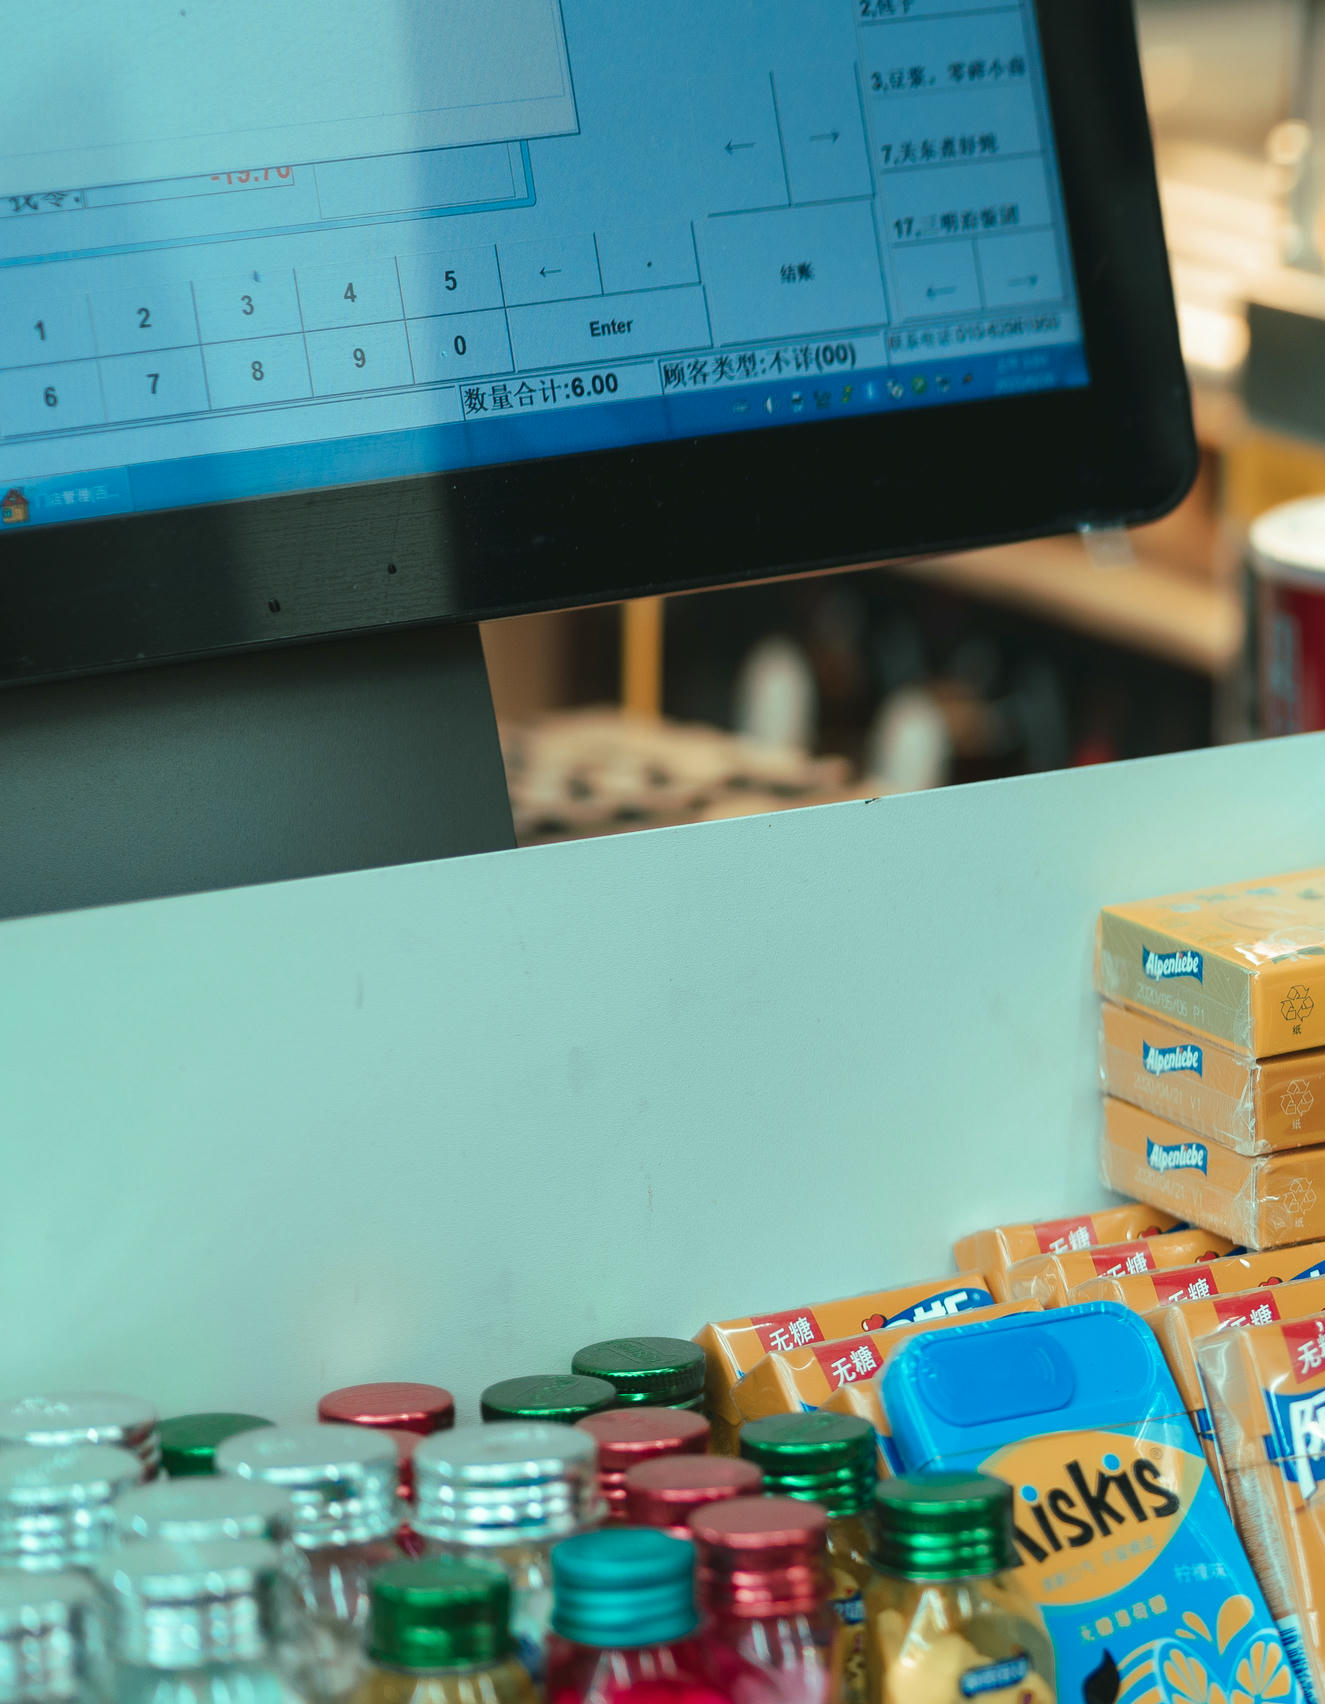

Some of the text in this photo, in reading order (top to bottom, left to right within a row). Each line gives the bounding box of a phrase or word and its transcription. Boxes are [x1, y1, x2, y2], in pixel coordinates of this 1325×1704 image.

[343, 282, 357, 302] 4
[444, 270, 459, 292] 5
[240, 294, 255, 316] 3
[137, 306, 152, 329] 2
[588, 318, 635, 337] Enter
[34, 320, 47, 341] 1
[453, 334, 468, 356] 0
[352, 347, 367, 369] 9
[251, 360, 265, 382] 8
[145, 373, 160, 394] 7
[463, 373, 619, 416] 数量合计:6.00
[43, 386, 58, 407] 6
[1146, 951, 1199, 981] Alpenliebe
[1292, 1024, 1302, 1035] 纸
[1147, 1046, 1199, 1077] Alpenliebe
[1150, 1144, 1204, 1174] Alpenliebe
[769, 1317, 815, 1351] 无糖
[831, 1346, 877, 1387] 无糖
